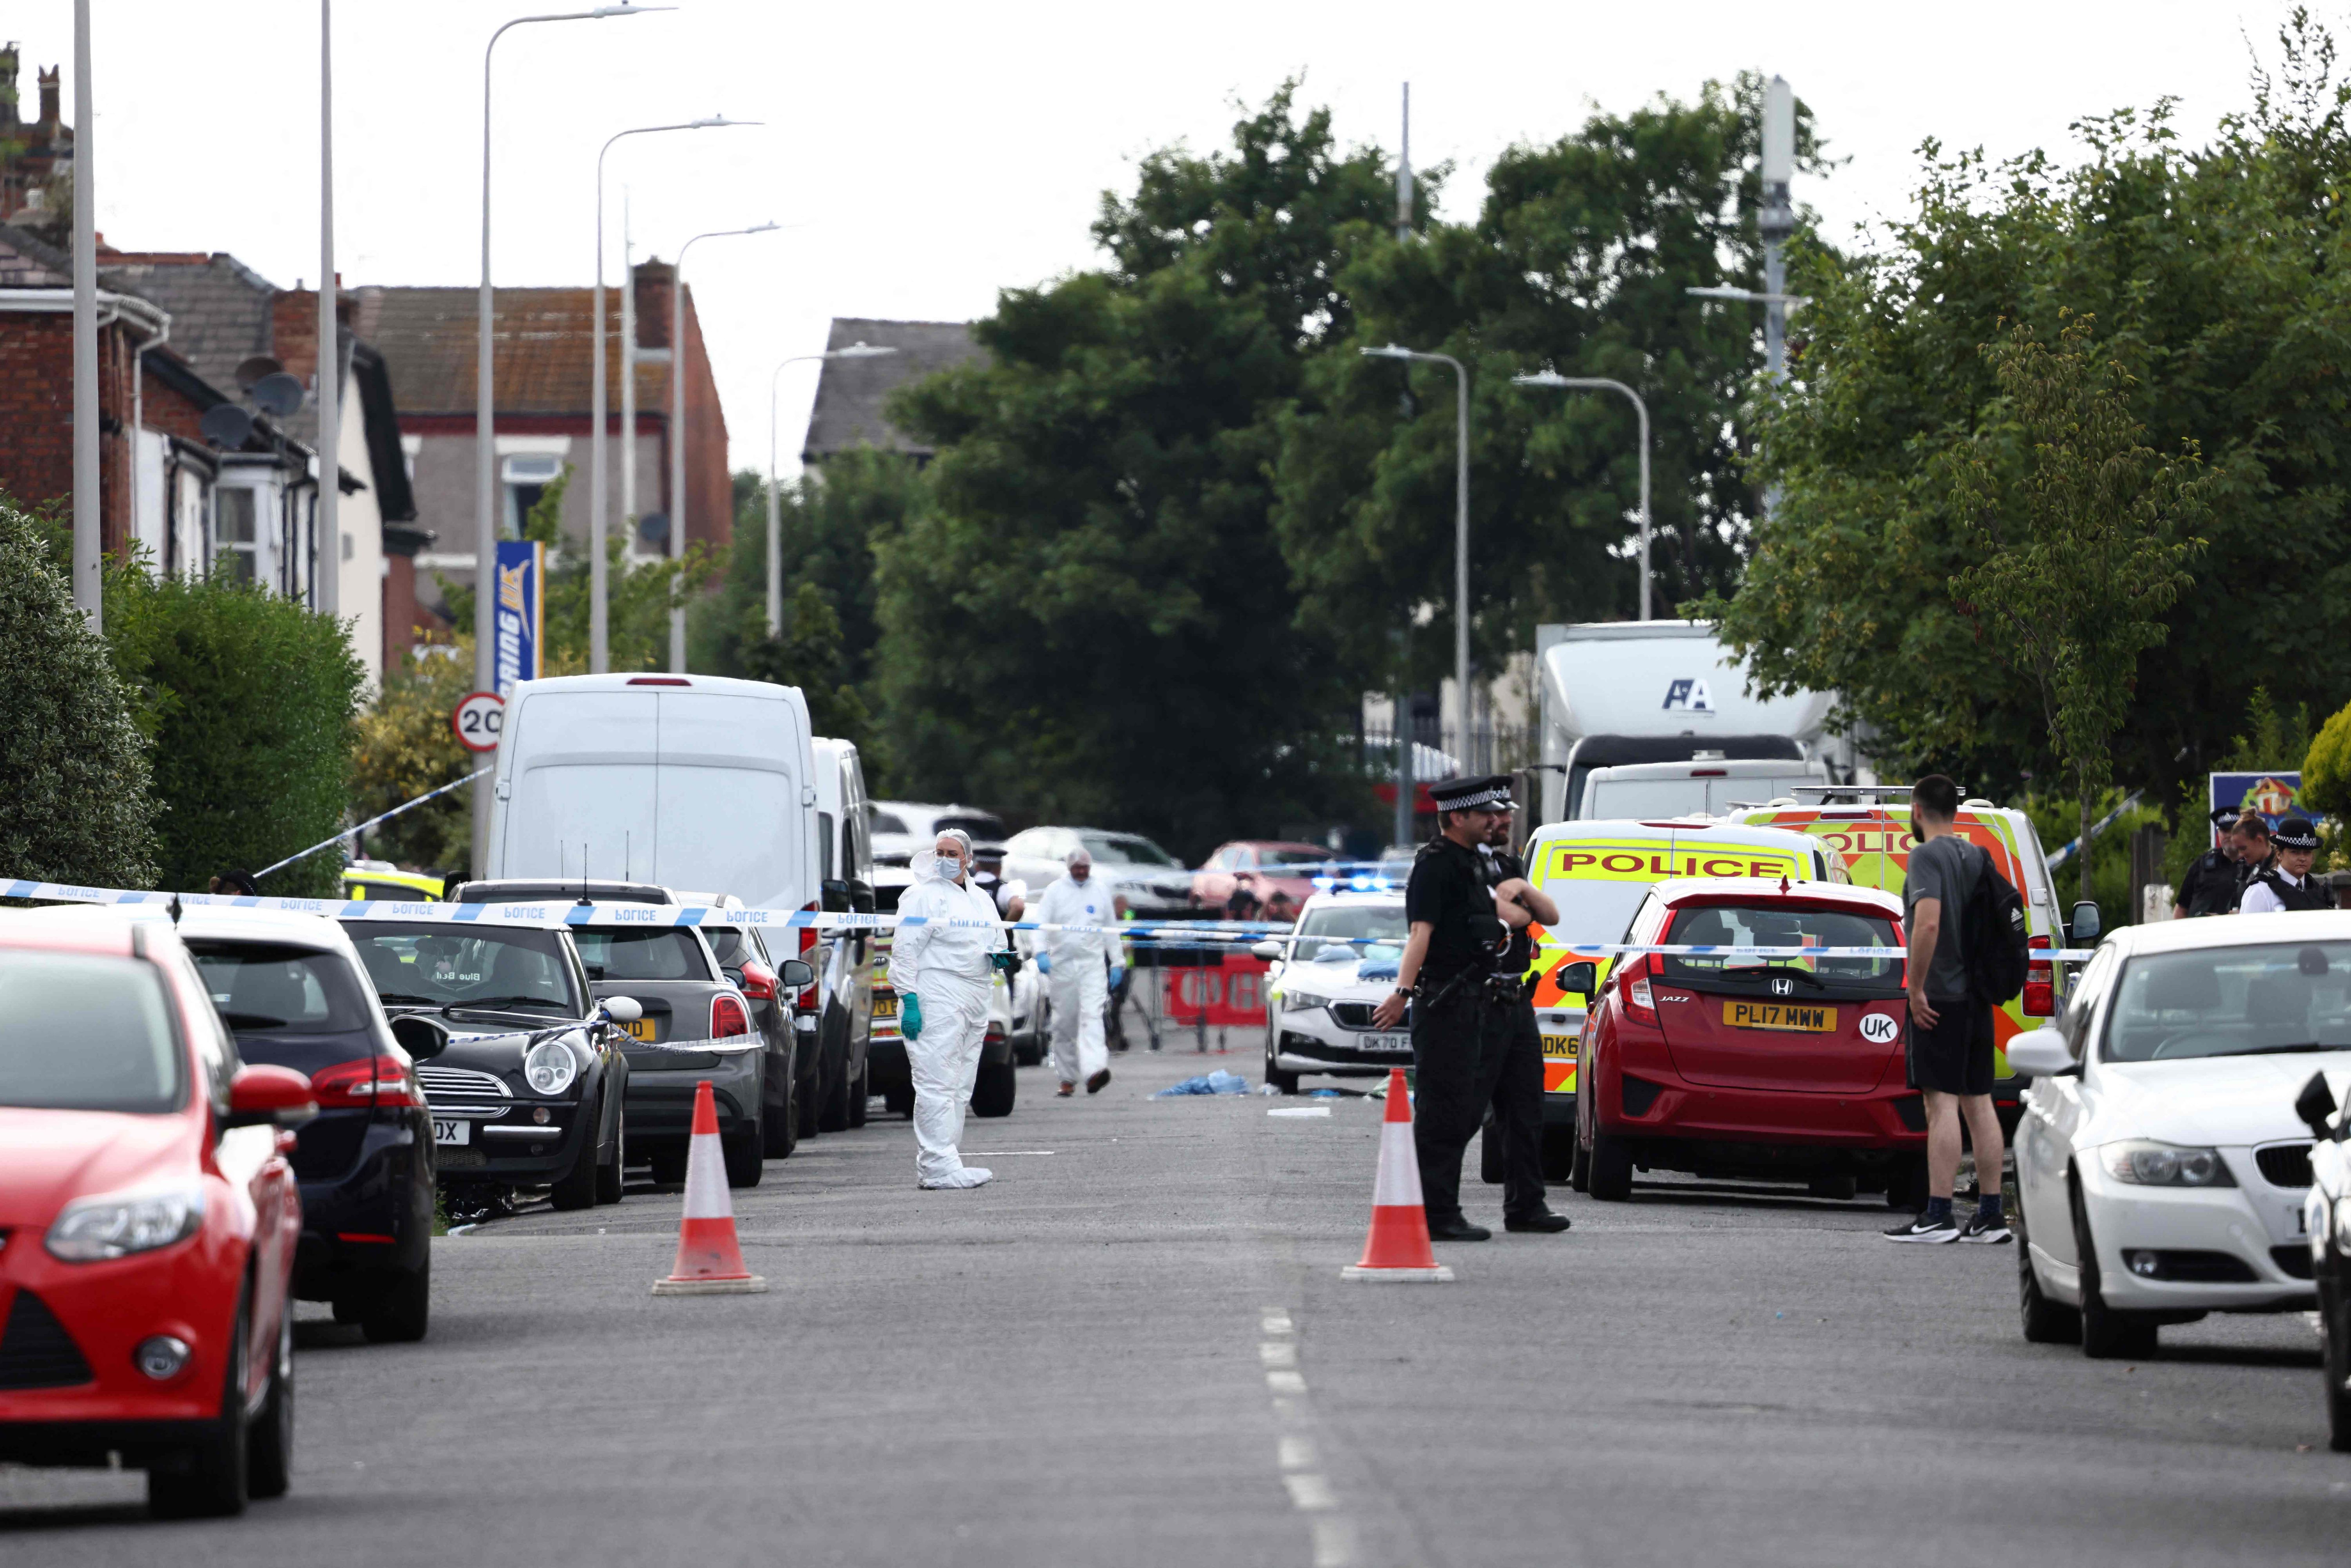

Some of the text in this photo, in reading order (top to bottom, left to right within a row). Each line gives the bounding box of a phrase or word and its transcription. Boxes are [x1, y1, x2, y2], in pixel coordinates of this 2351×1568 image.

[1662, 679, 1715, 710] AA
[1563, 853, 1784, 878] POLICE
[1735, 1004, 1824, 1028] PL17 MWW
[1864, 1018, 1893, 1039] UK
[1364, 1036, 1397, 1048] DK70
[1543, 1037, 1579, 1054] DK6
[434, 1122, 457, 1141] DX
